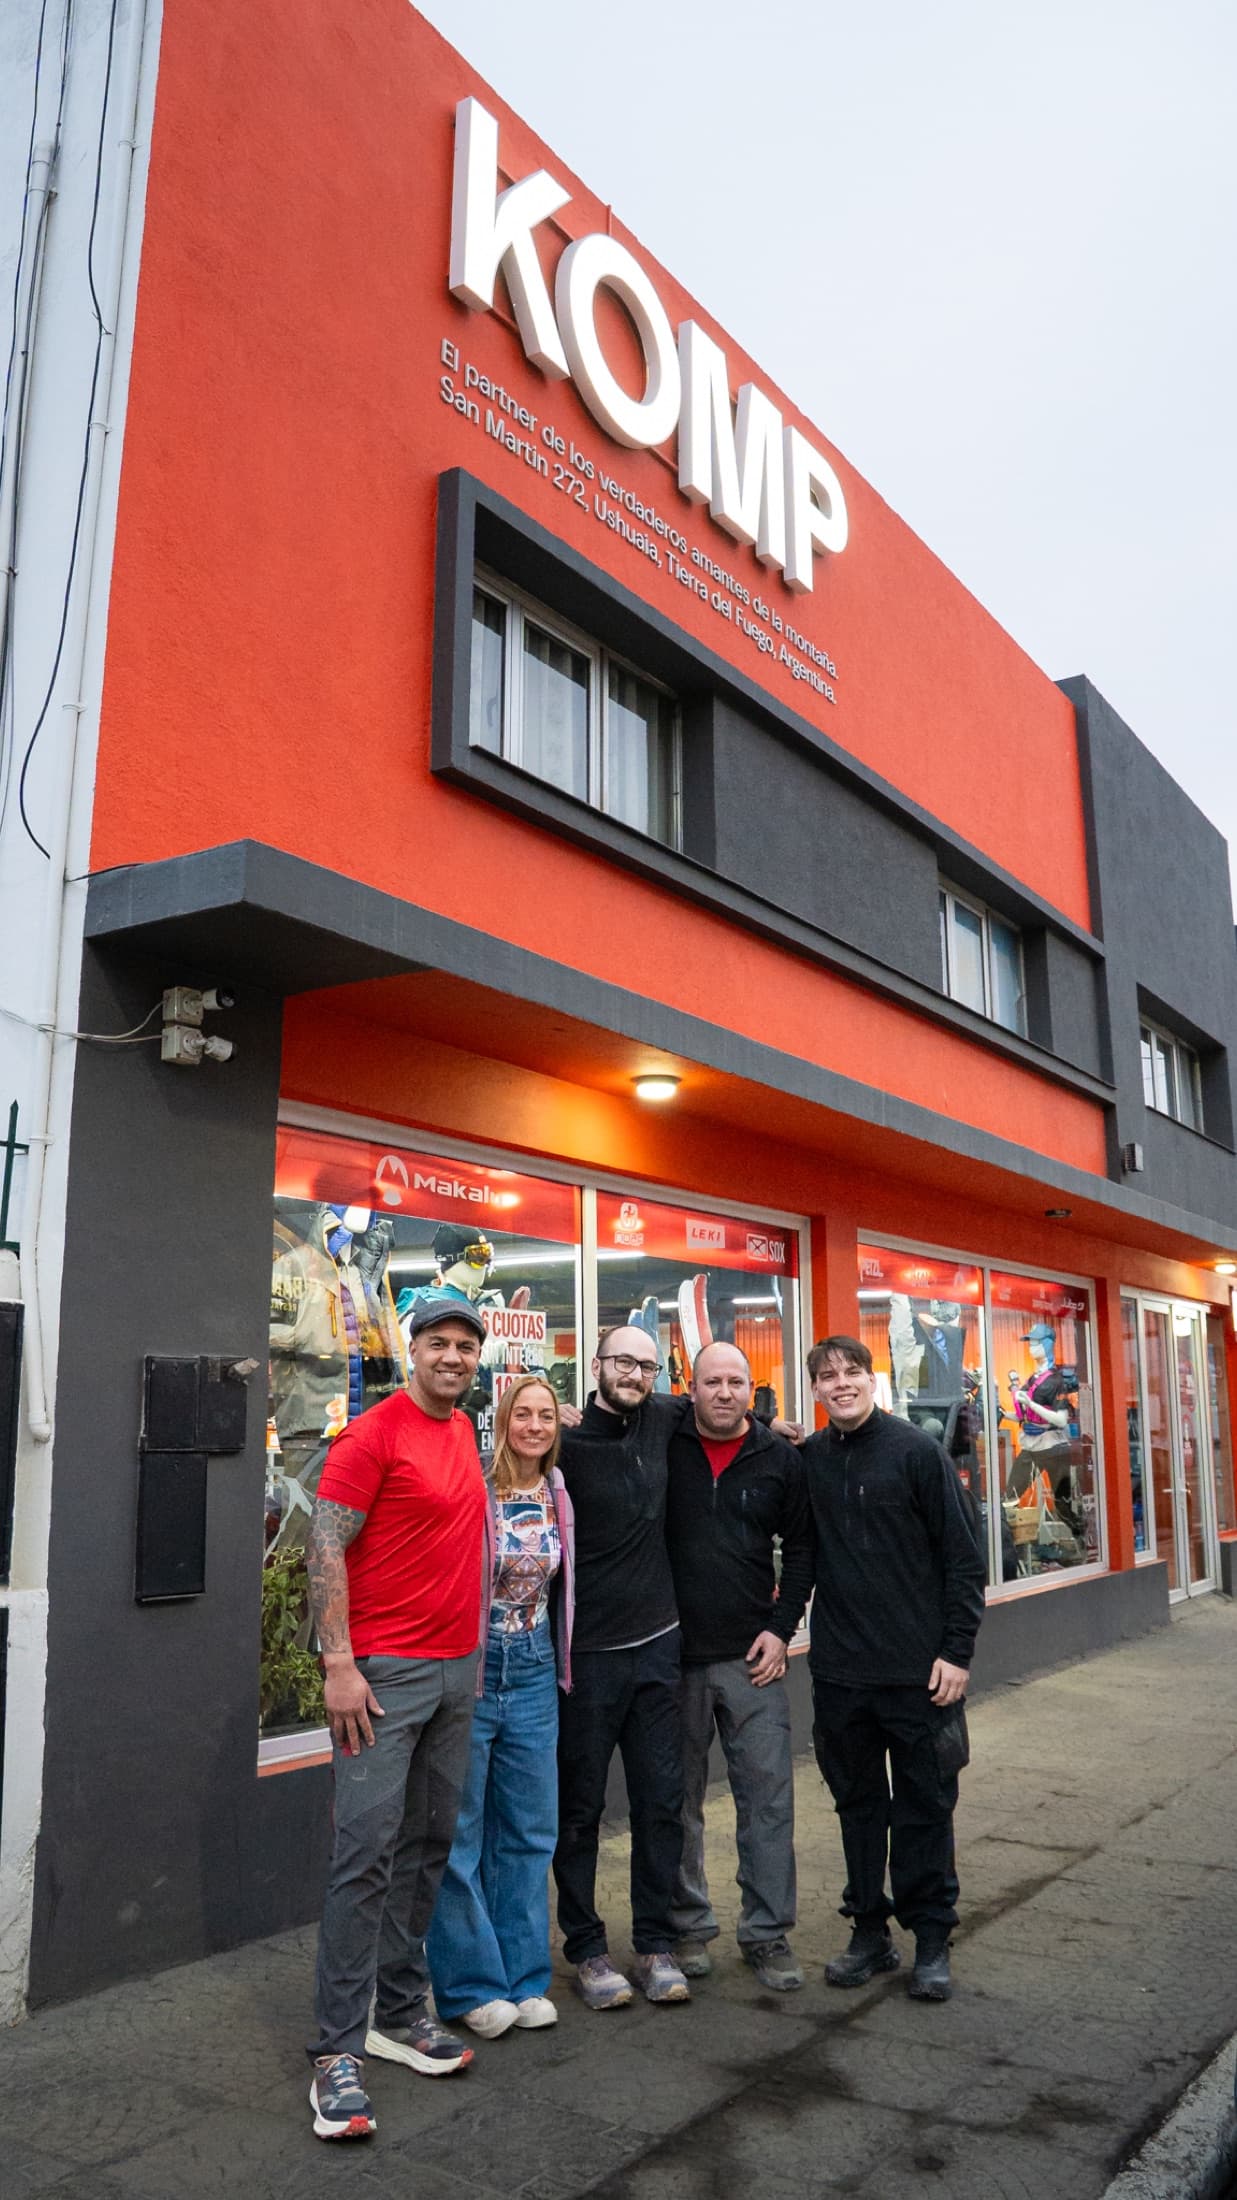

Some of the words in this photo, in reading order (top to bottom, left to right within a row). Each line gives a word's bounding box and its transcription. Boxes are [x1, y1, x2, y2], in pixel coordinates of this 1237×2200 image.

[449, 96, 849, 594] KOMP
[440, 375, 480, 425] San
[552, 463, 590, 513] 272,
[594, 493, 663, 568] Ushuaia,
[665, 549, 709, 601] Tierra
[711, 591, 733, 620] del
[735, 604, 777, 660] Fuego,
[778, 643, 838, 705] Argentina.
[441, 338, 459, 373] El
[464, 362, 538, 433] partner
[542, 425, 566, 456] de
[569, 441, 595, 480] los
[598, 470, 688, 555] verdaderos
[690, 546, 750, 606] amantes
[752, 595, 770, 622] de
[771, 607, 783, 633] la
[785, 623, 839, 680] montaña.
[691, 1227, 722, 1242] LEKI
[768, 1240, 786, 1264] SOX
[481, 1311, 489, 1333] 6
[492, 1311, 544, 1341] CUOTAS
